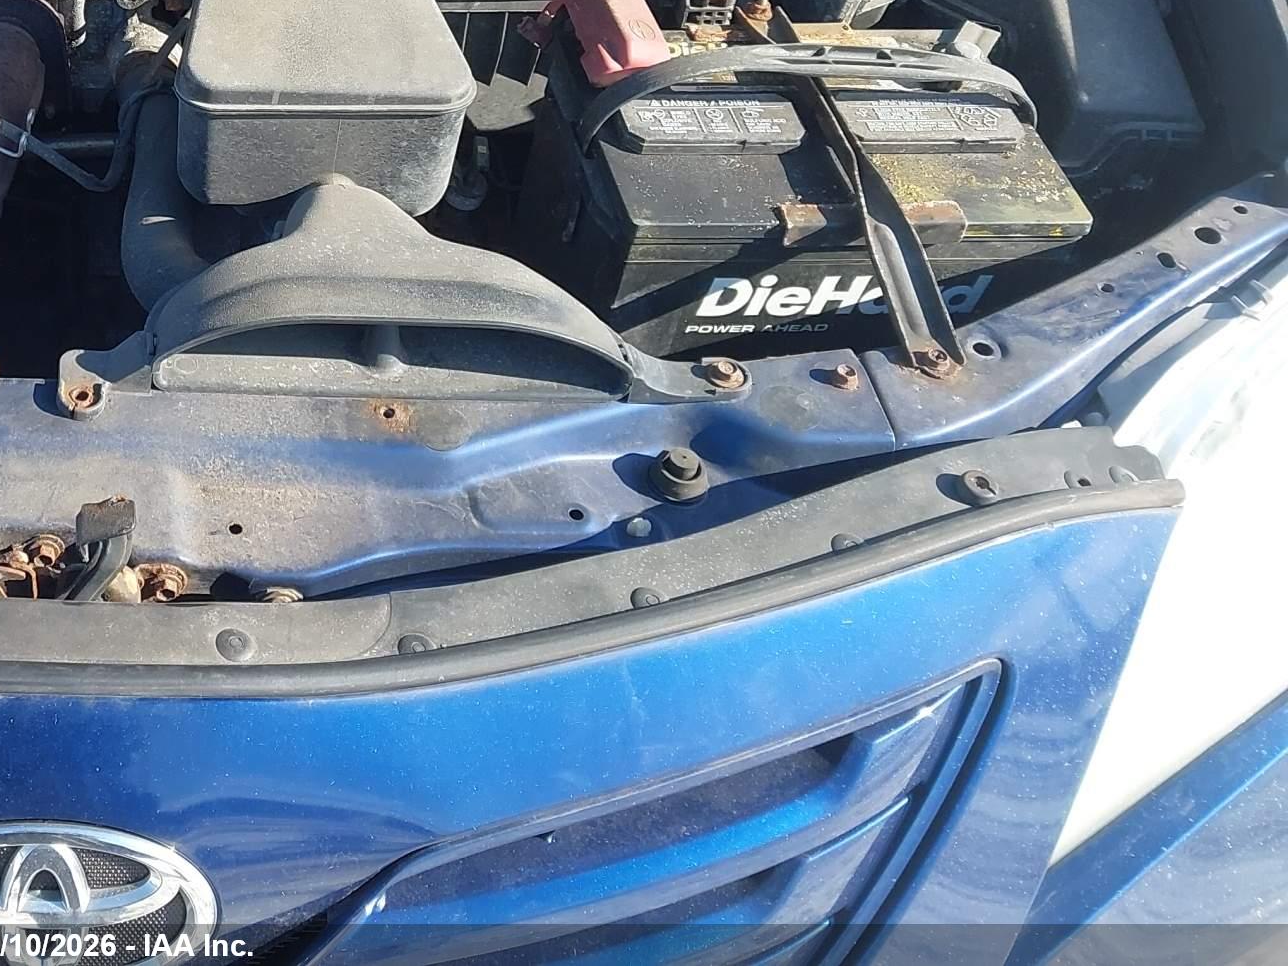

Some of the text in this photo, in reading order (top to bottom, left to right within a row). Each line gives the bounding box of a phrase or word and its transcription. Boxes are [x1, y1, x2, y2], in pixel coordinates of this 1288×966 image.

[662, 99, 707, 107] DANGER
[719, 99, 760, 107] POISON
[695, 273, 996, 318] DieHad
[684, 322, 829, 334] POWER AHEAD
